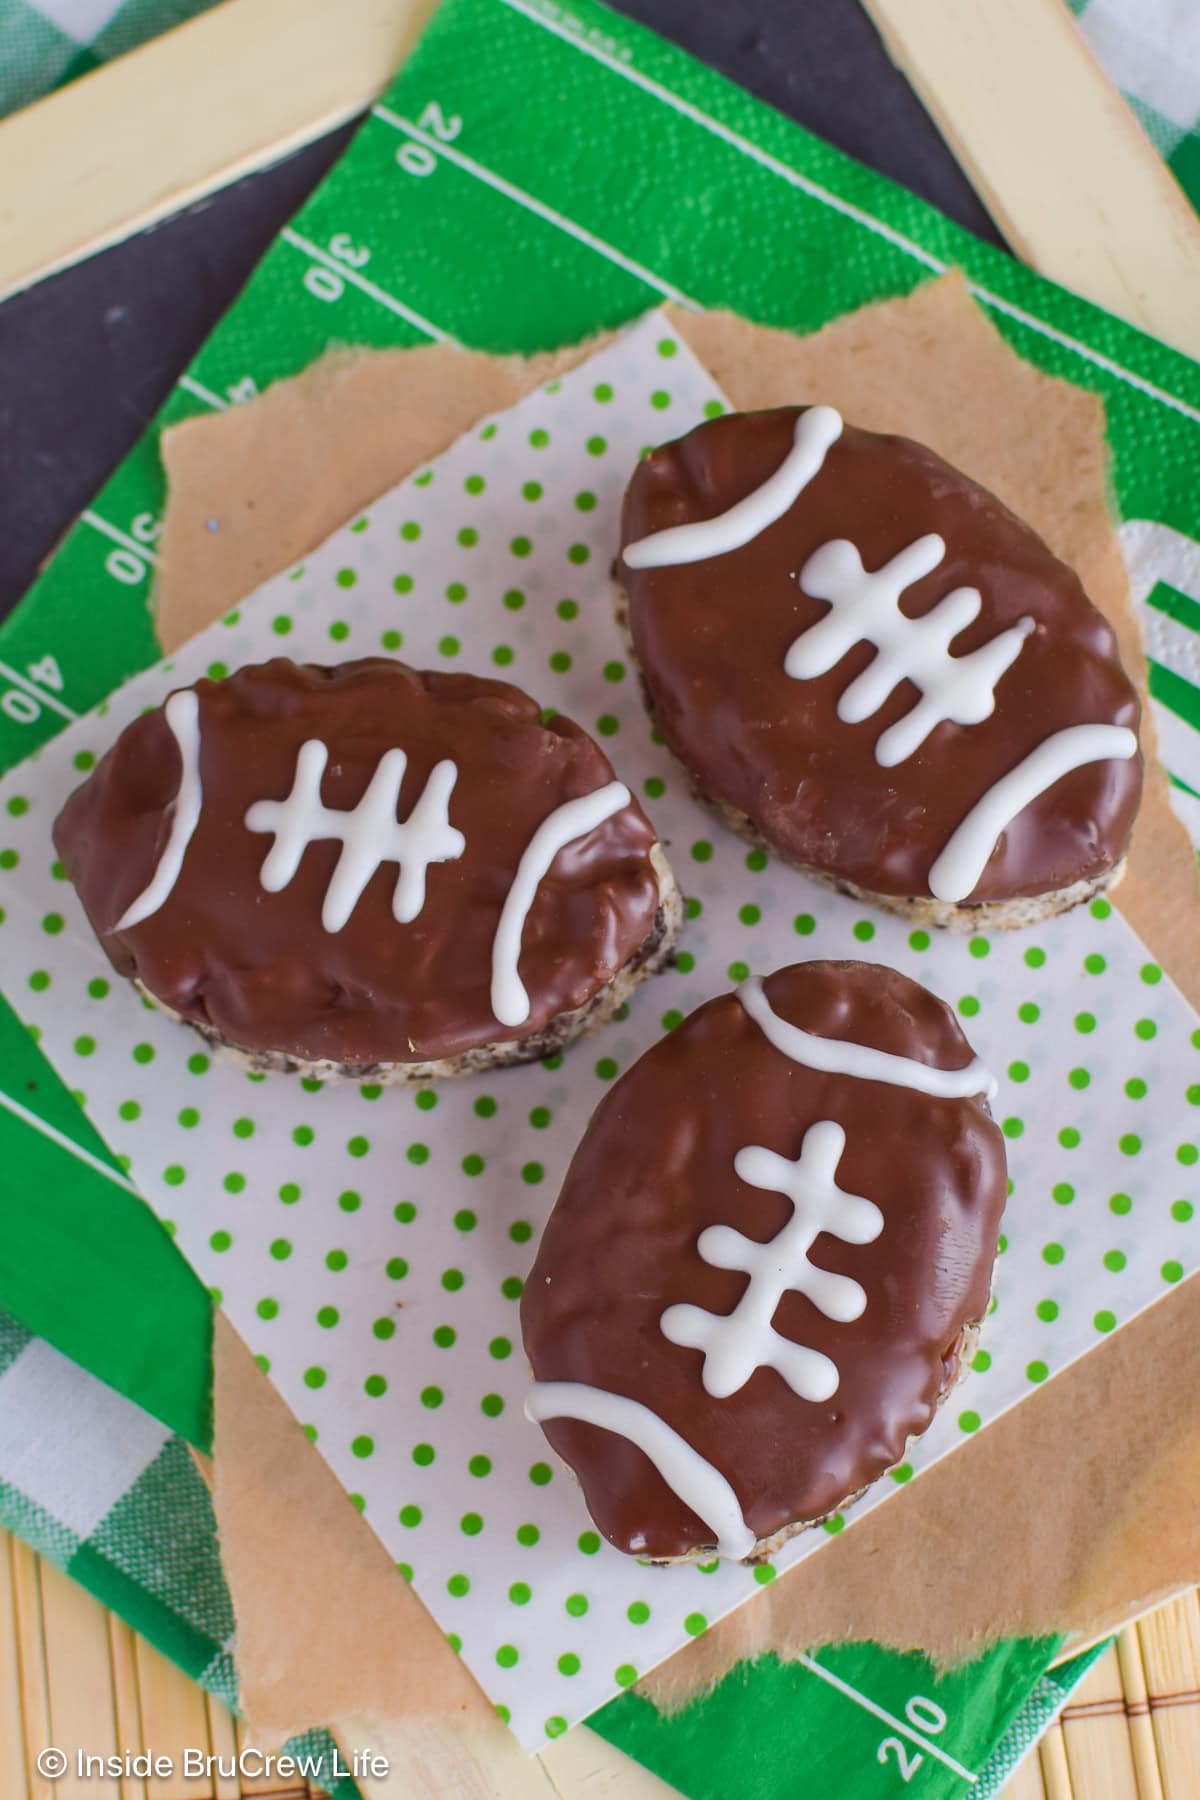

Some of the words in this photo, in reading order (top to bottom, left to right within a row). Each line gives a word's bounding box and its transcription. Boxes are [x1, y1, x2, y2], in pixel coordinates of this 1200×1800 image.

[396, 102, 462, 176] 20
[304, 235, 371, 303] 30
[1, 655, 64, 724] 40
[877, 1695, 947, 1782] 20
